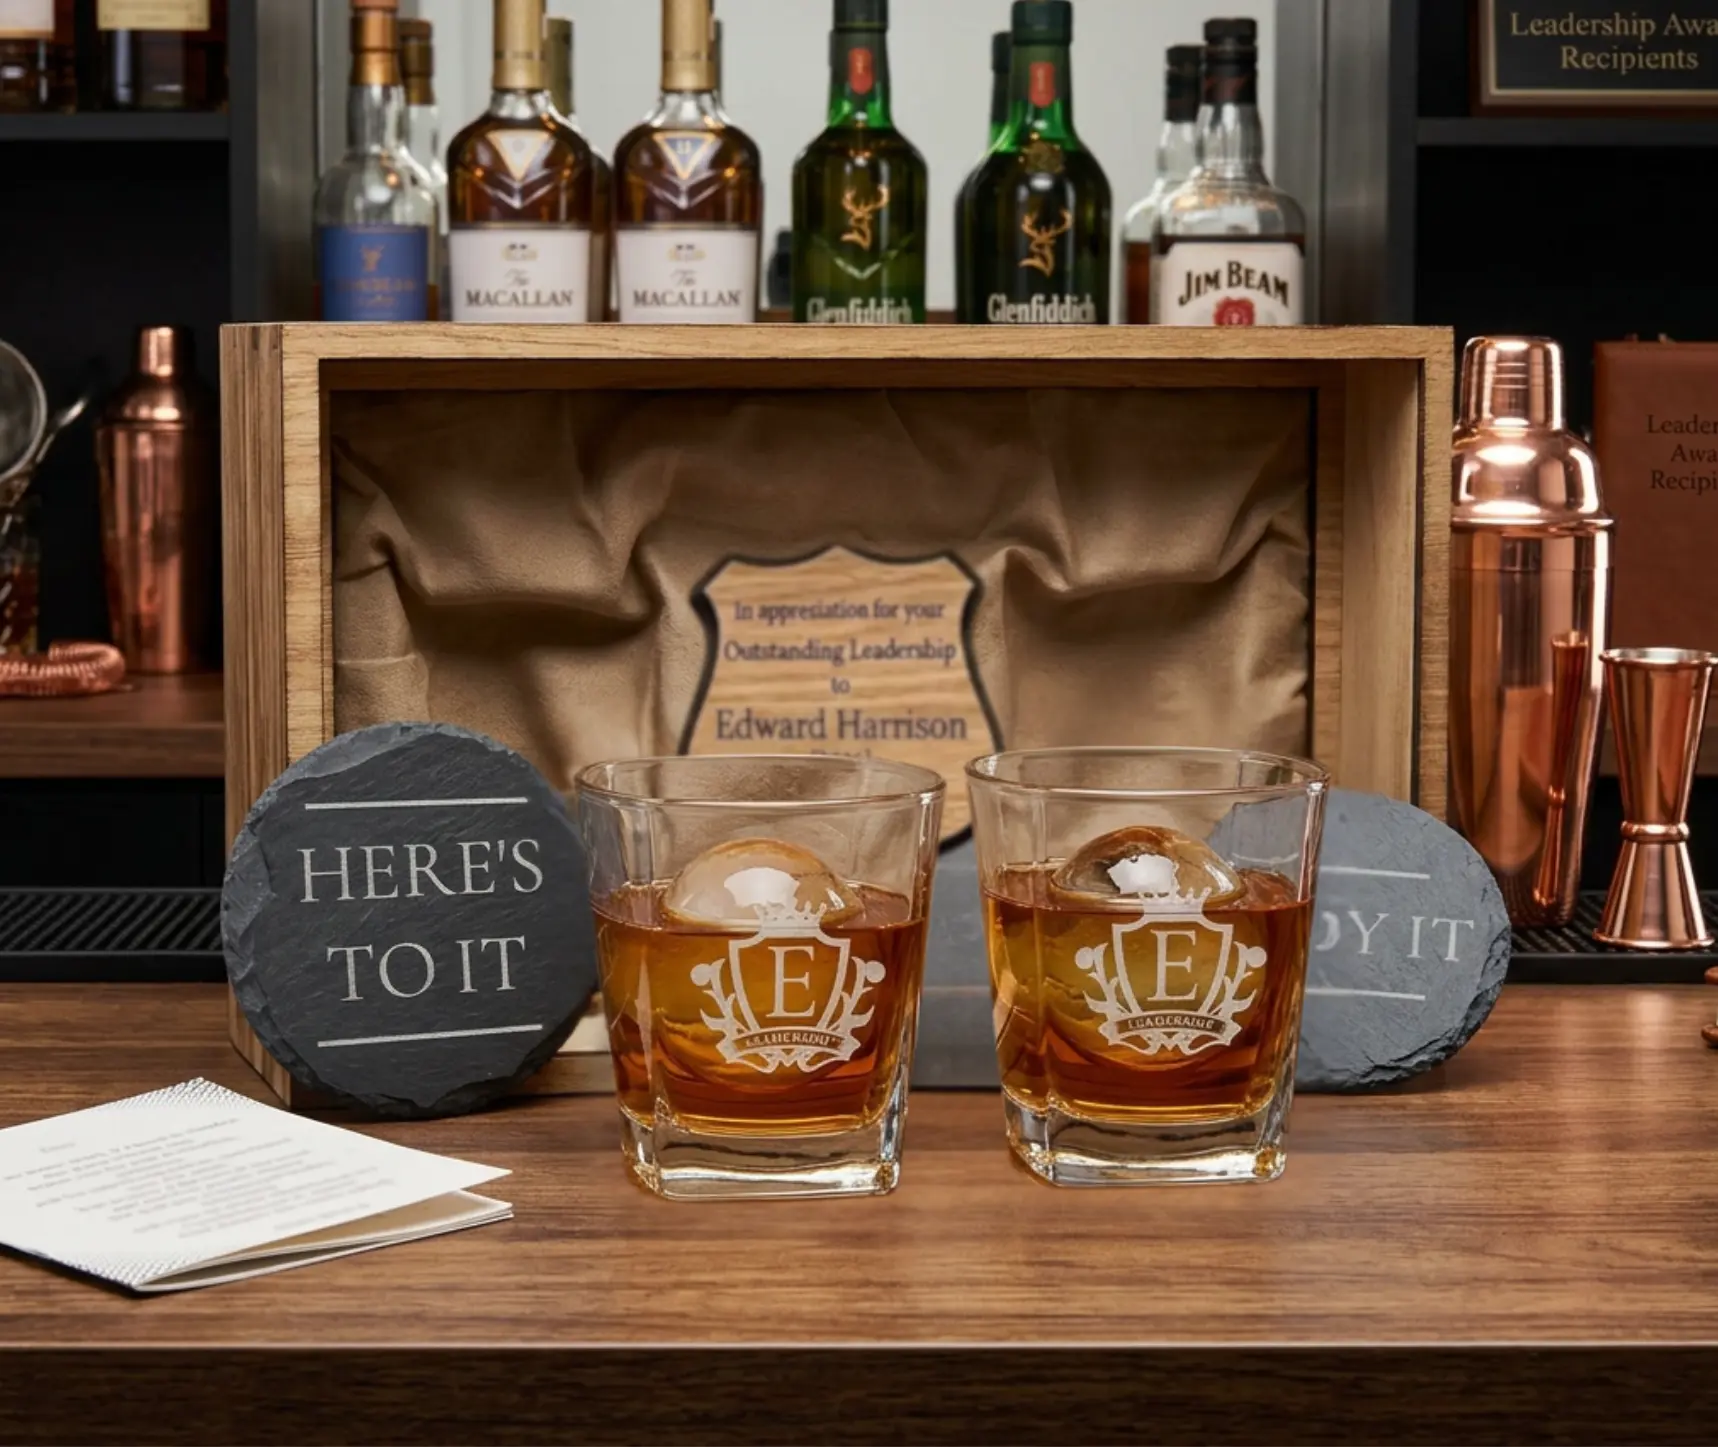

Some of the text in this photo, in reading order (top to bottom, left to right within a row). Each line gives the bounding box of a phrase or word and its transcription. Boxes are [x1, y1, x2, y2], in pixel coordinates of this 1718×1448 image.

[1510, 12, 1656, 42] Leadership
[1560, 45, 1699, 75] Recipients
[465, 289, 573, 307] MACALLAN
[633, 290, 741, 307] MACALLAN
[1178, 260, 1289, 307] JIM BEAM
[987, 293, 1096, 323] Glenfiddich
[1671, 443, 1718, 462] Awa
[1651, 469, 1718, 496] Recipi
[734, 601, 753, 620] In
[873, 597, 899, 619] for
[903, 603, 946, 625] your
[723, 638, 957, 667] Outstanding Leadership
[830, 676, 851, 695] to
[716, 707, 968, 740] Edward Harrison
[297, 839, 544, 903] HERE'S
[1407, 915, 1474, 963] IT
[326, 935, 525, 1002] TO IT
[1147, 928, 1198, 1001] E
[766, 945, 816, 1018] E
